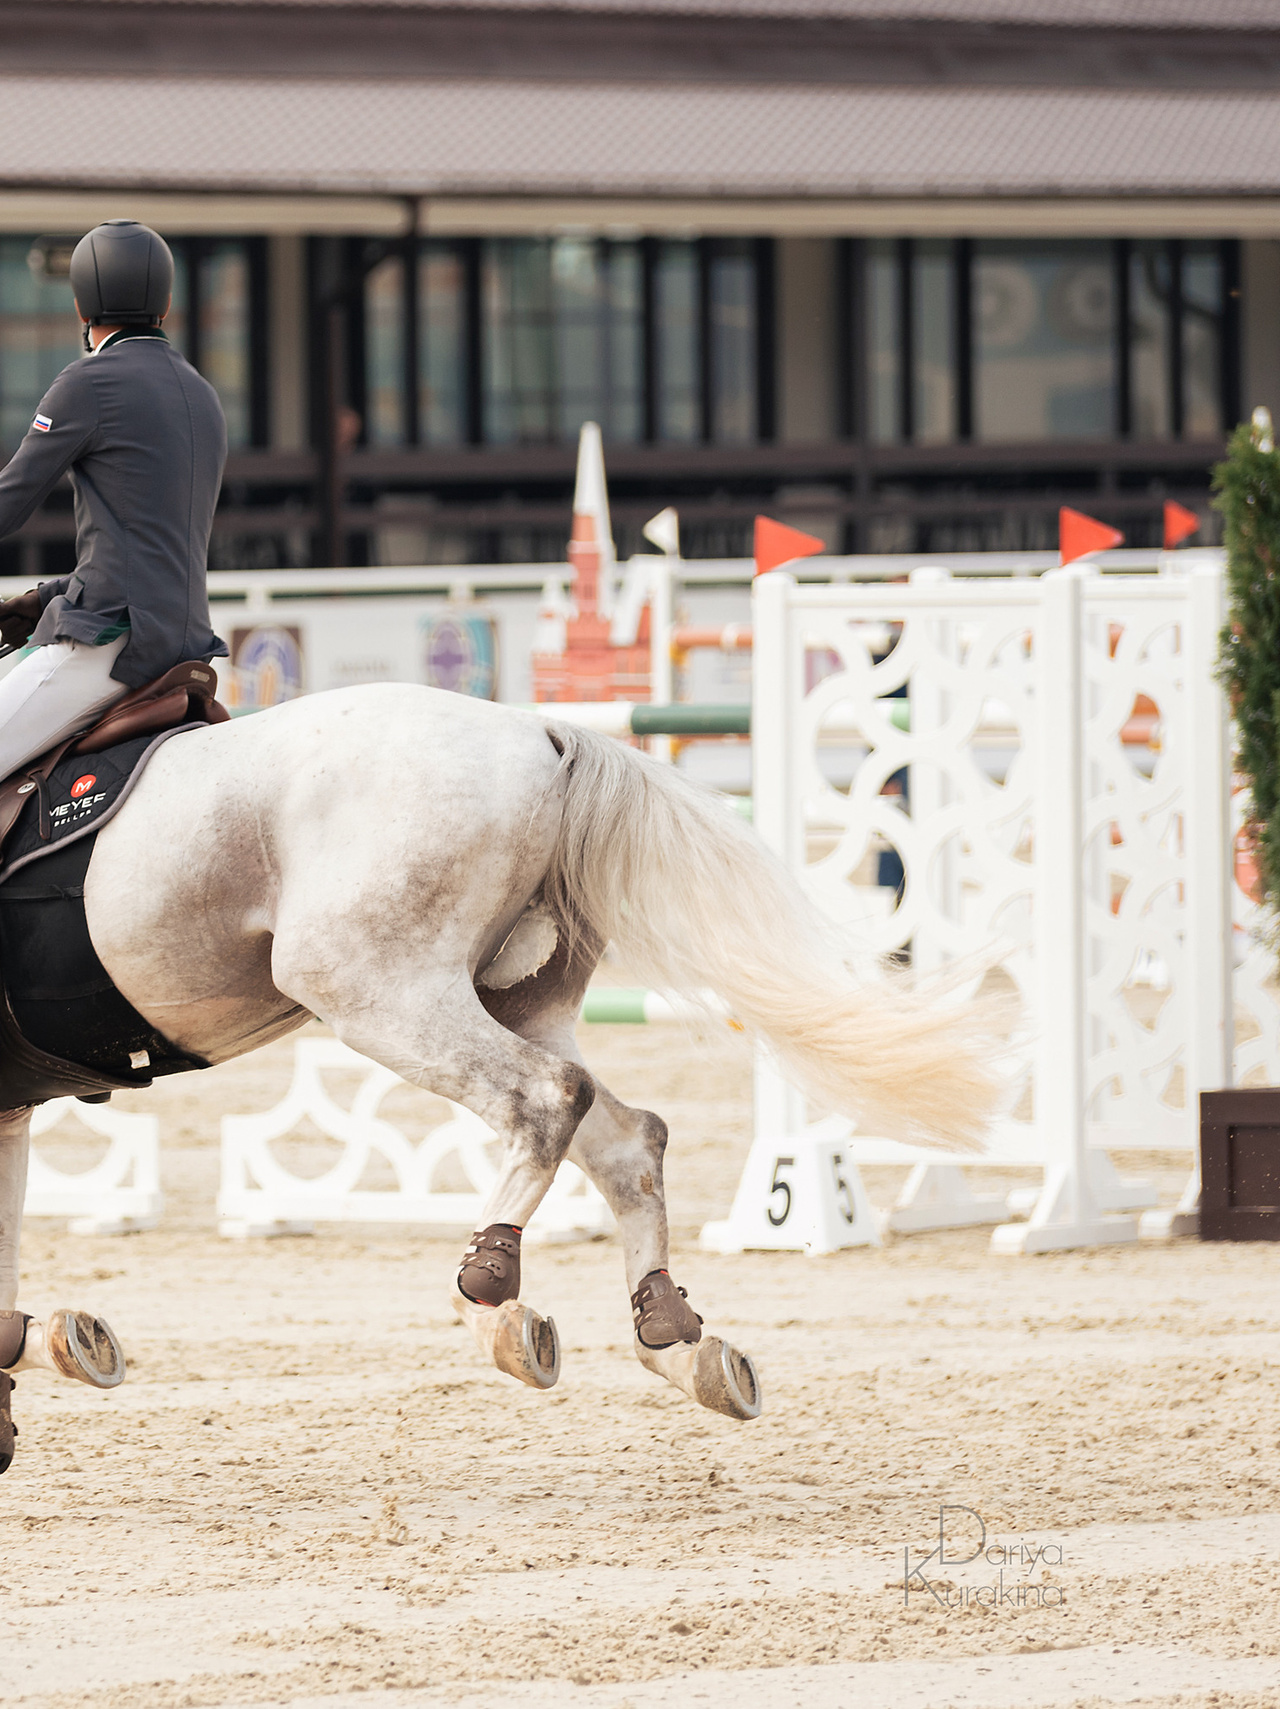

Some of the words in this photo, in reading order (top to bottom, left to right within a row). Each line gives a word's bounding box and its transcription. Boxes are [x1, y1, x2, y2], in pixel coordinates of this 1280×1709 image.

[75, 780, 93, 794] M
[767, 1157, 794, 1226] 5
[832, 1155, 854, 1224] 5
